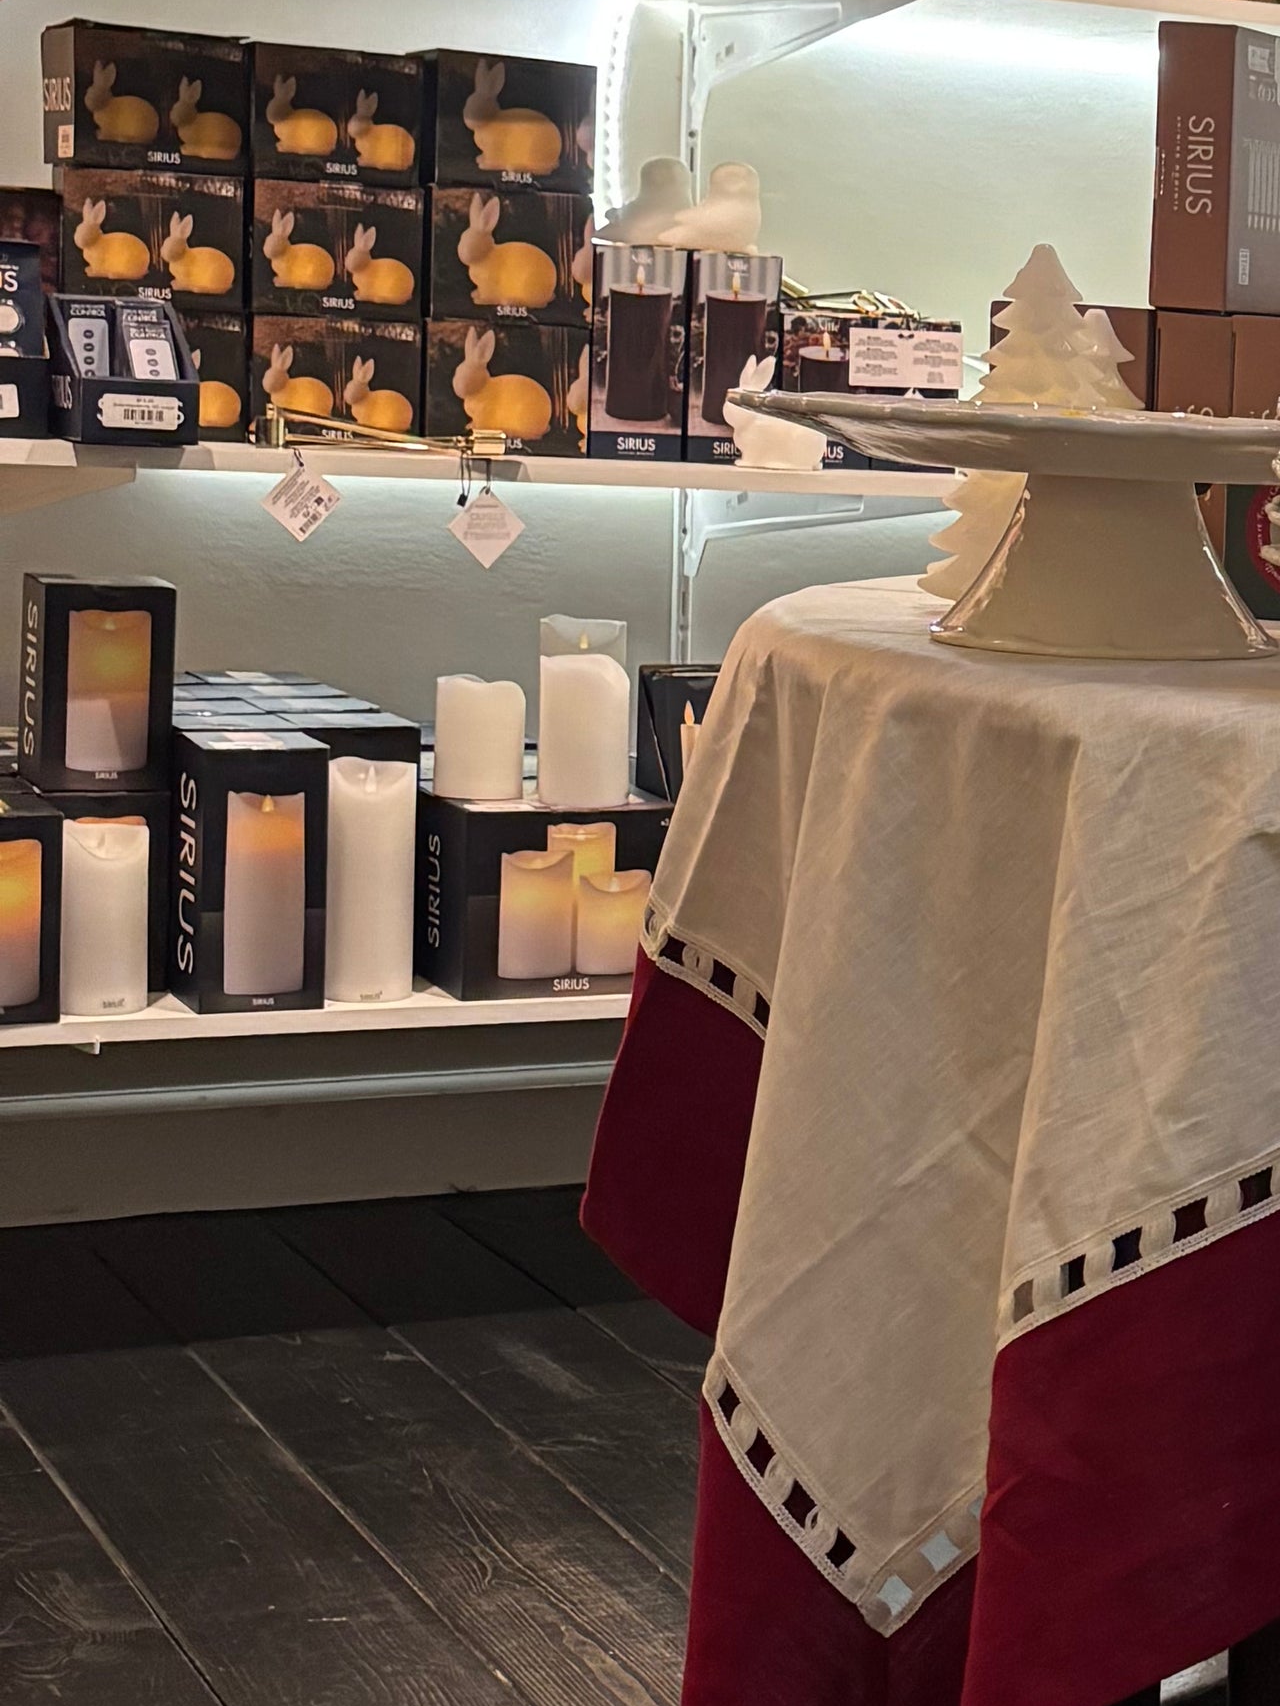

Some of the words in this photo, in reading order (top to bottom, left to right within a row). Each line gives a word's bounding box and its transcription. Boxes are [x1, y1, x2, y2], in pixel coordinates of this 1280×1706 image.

[43, 76, 72, 112] SIRIUS
[146, 150, 182, 165] SIRIUS
[1185, 115, 1216, 215] SIRIUS
[325, 161, 358, 176] SIRIUS
[501, 171, 533, 185] SIRIUS
[138, 285, 172, 300] SIRIUS
[322, 296, 355, 310] SIRIUS
[496, 305, 528, 318] SIRIUS
[616, 435, 656, 452] SIRIUS
[713, 441, 741, 456] SIRI
[23, 600, 38, 756] SIRIUS
[177, 772, 197, 975] SIRIUS
[427, 833, 441, 948] SIRIUS
[552, 977, 591, 992] SIRIUS
